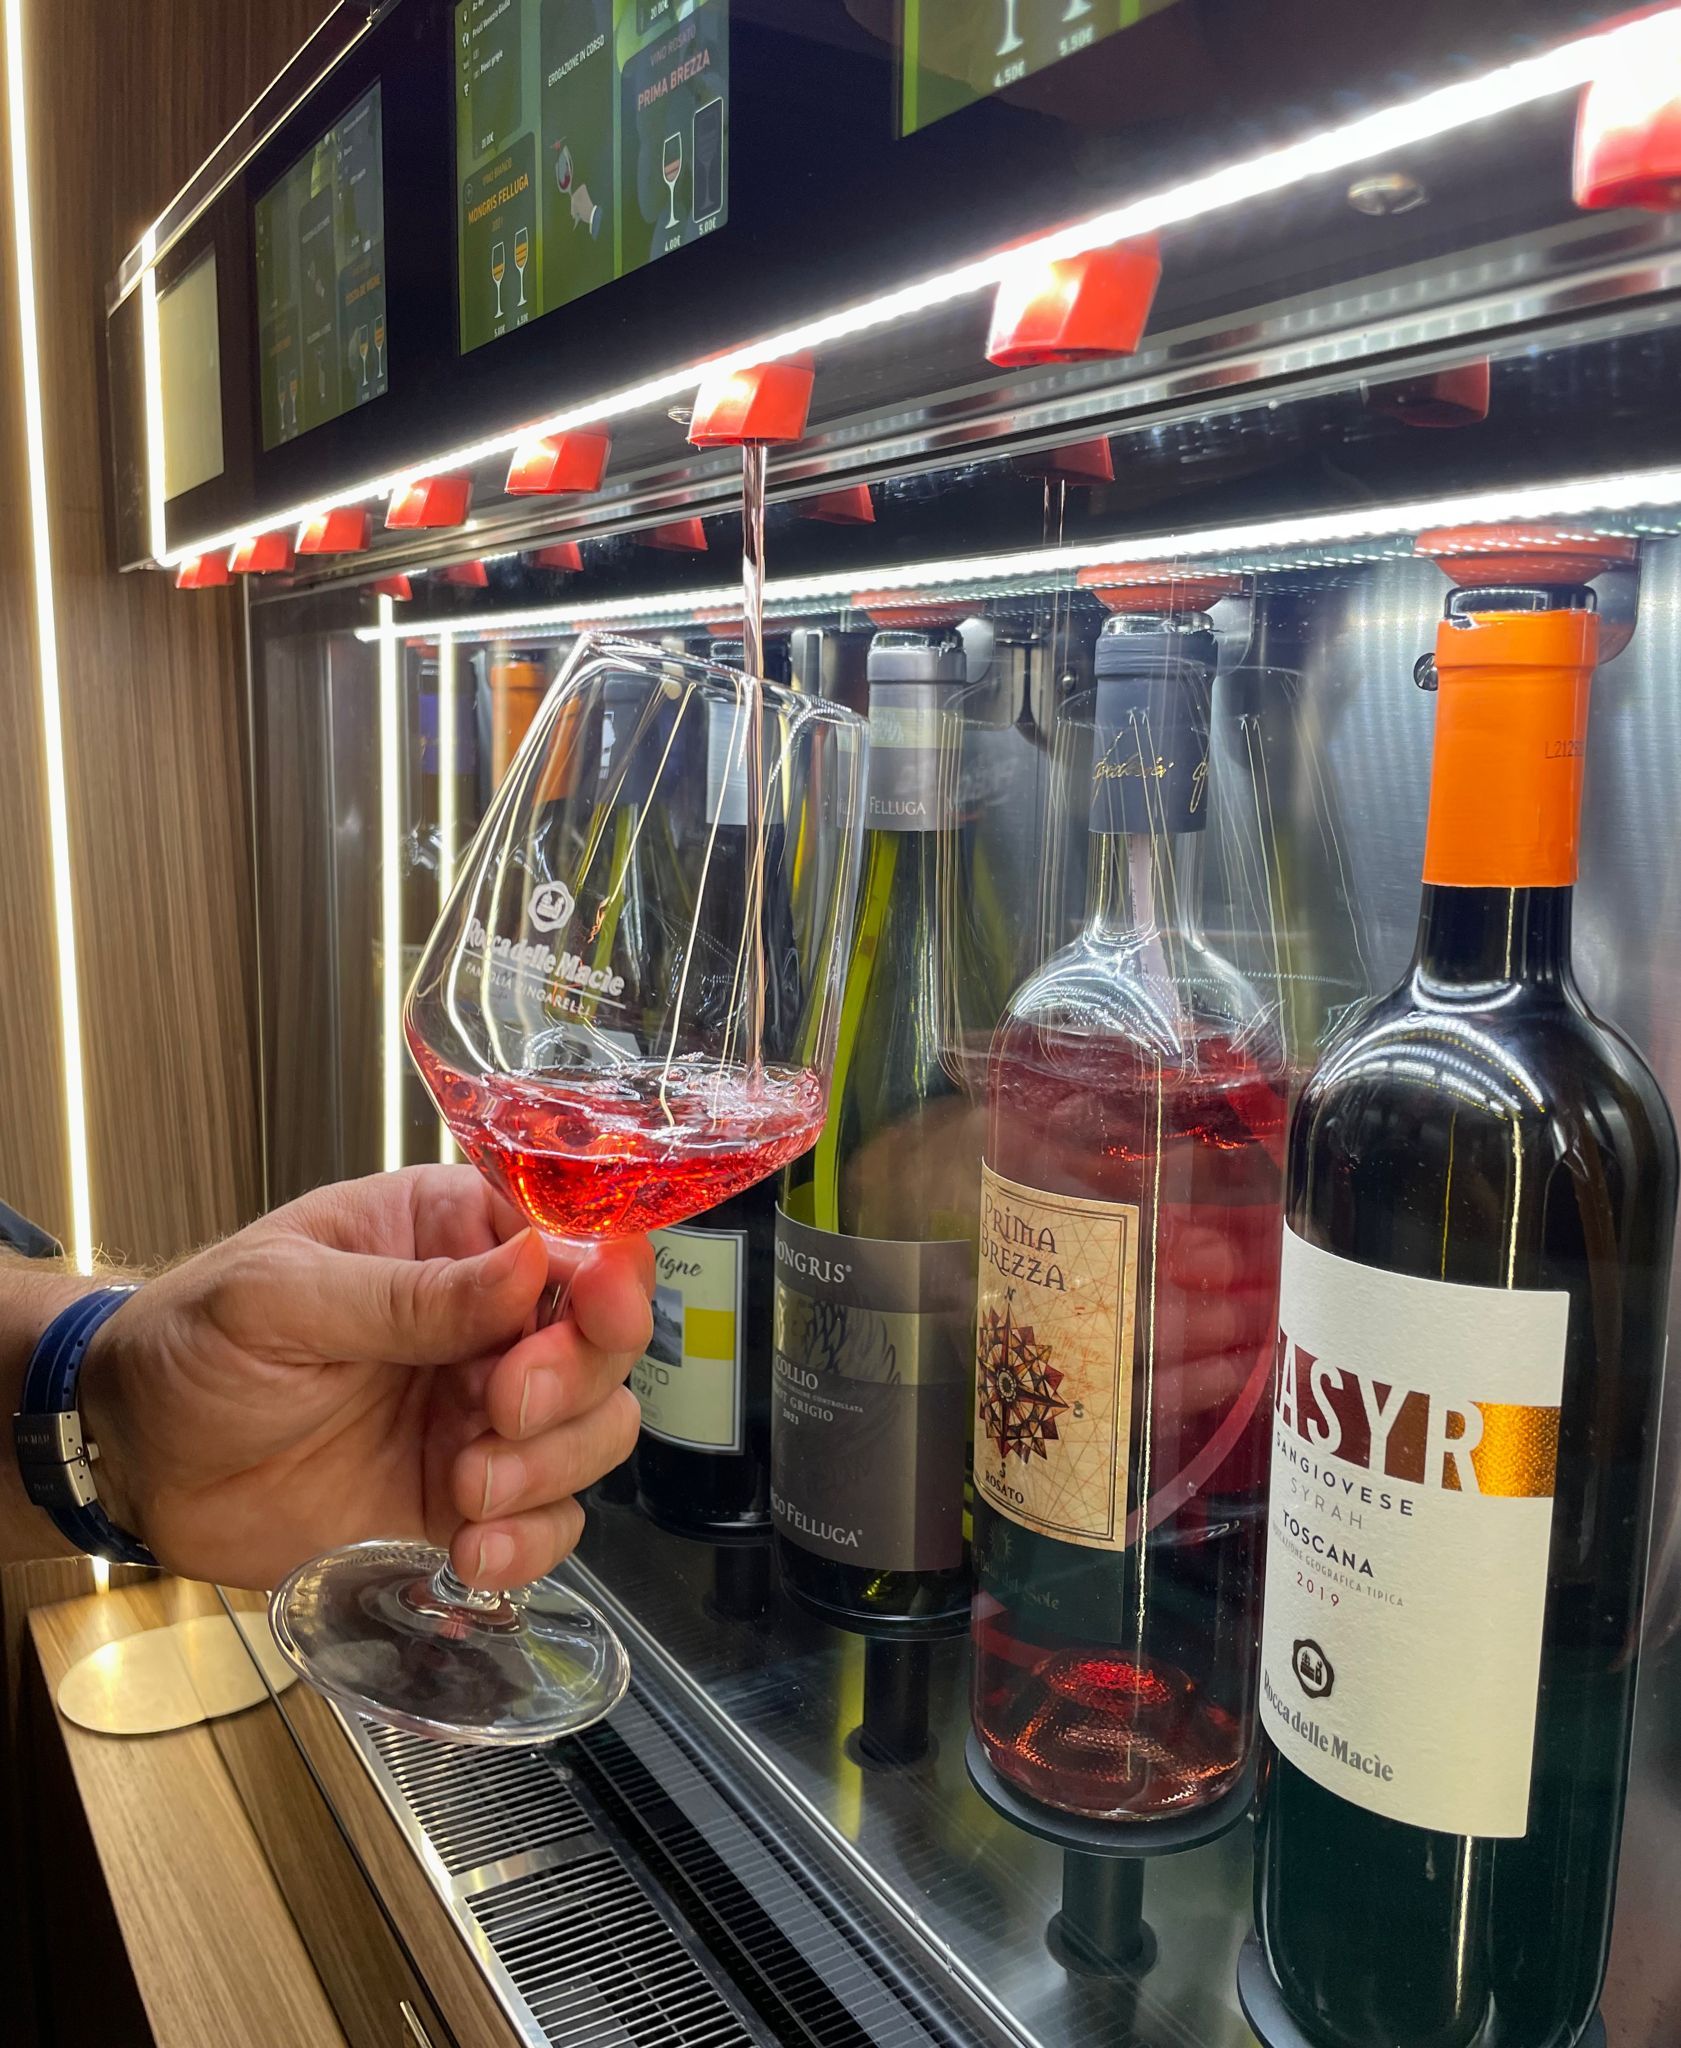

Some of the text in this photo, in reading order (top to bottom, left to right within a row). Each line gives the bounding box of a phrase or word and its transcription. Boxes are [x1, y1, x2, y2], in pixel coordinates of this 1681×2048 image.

[548, 52, 580, 87] EROGAZIONE
[586, 33, 605, 57] CORSO
[638, 47, 710, 112] PRIMA BREZZA
[467, 172, 529, 225] MONGRIS FELLUGA
[698, 216, 717, 236] 5.00€
[869, 795, 926, 816] FELLUGA
[467, 917, 512, 958] Roca
[510, 938, 557, 974] delle
[981, 1222, 1067, 1292] BREZZA
[775, 1354, 819, 1391] COLLIO
[789, 1396, 834, 1422] GRIGIO
[1276, 1329, 1484, 1497] ASYR
[985, 1470, 1025, 1504] ROSATO
[1276, 1431, 1414, 1517] SANGIOVESE
[1291, 1477, 1363, 1530] SYRAH
[1282, 1508, 1375, 1578] TOSCANA
[1297, 1571, 1340, 1607] 2019
[1306, 1555, 1362, 1593] GEOGRAFICA
[1367, 1586, 1404, 1607] TIPICA
[1263, 1668, 1394, 1782] Rocca delle Macìe
